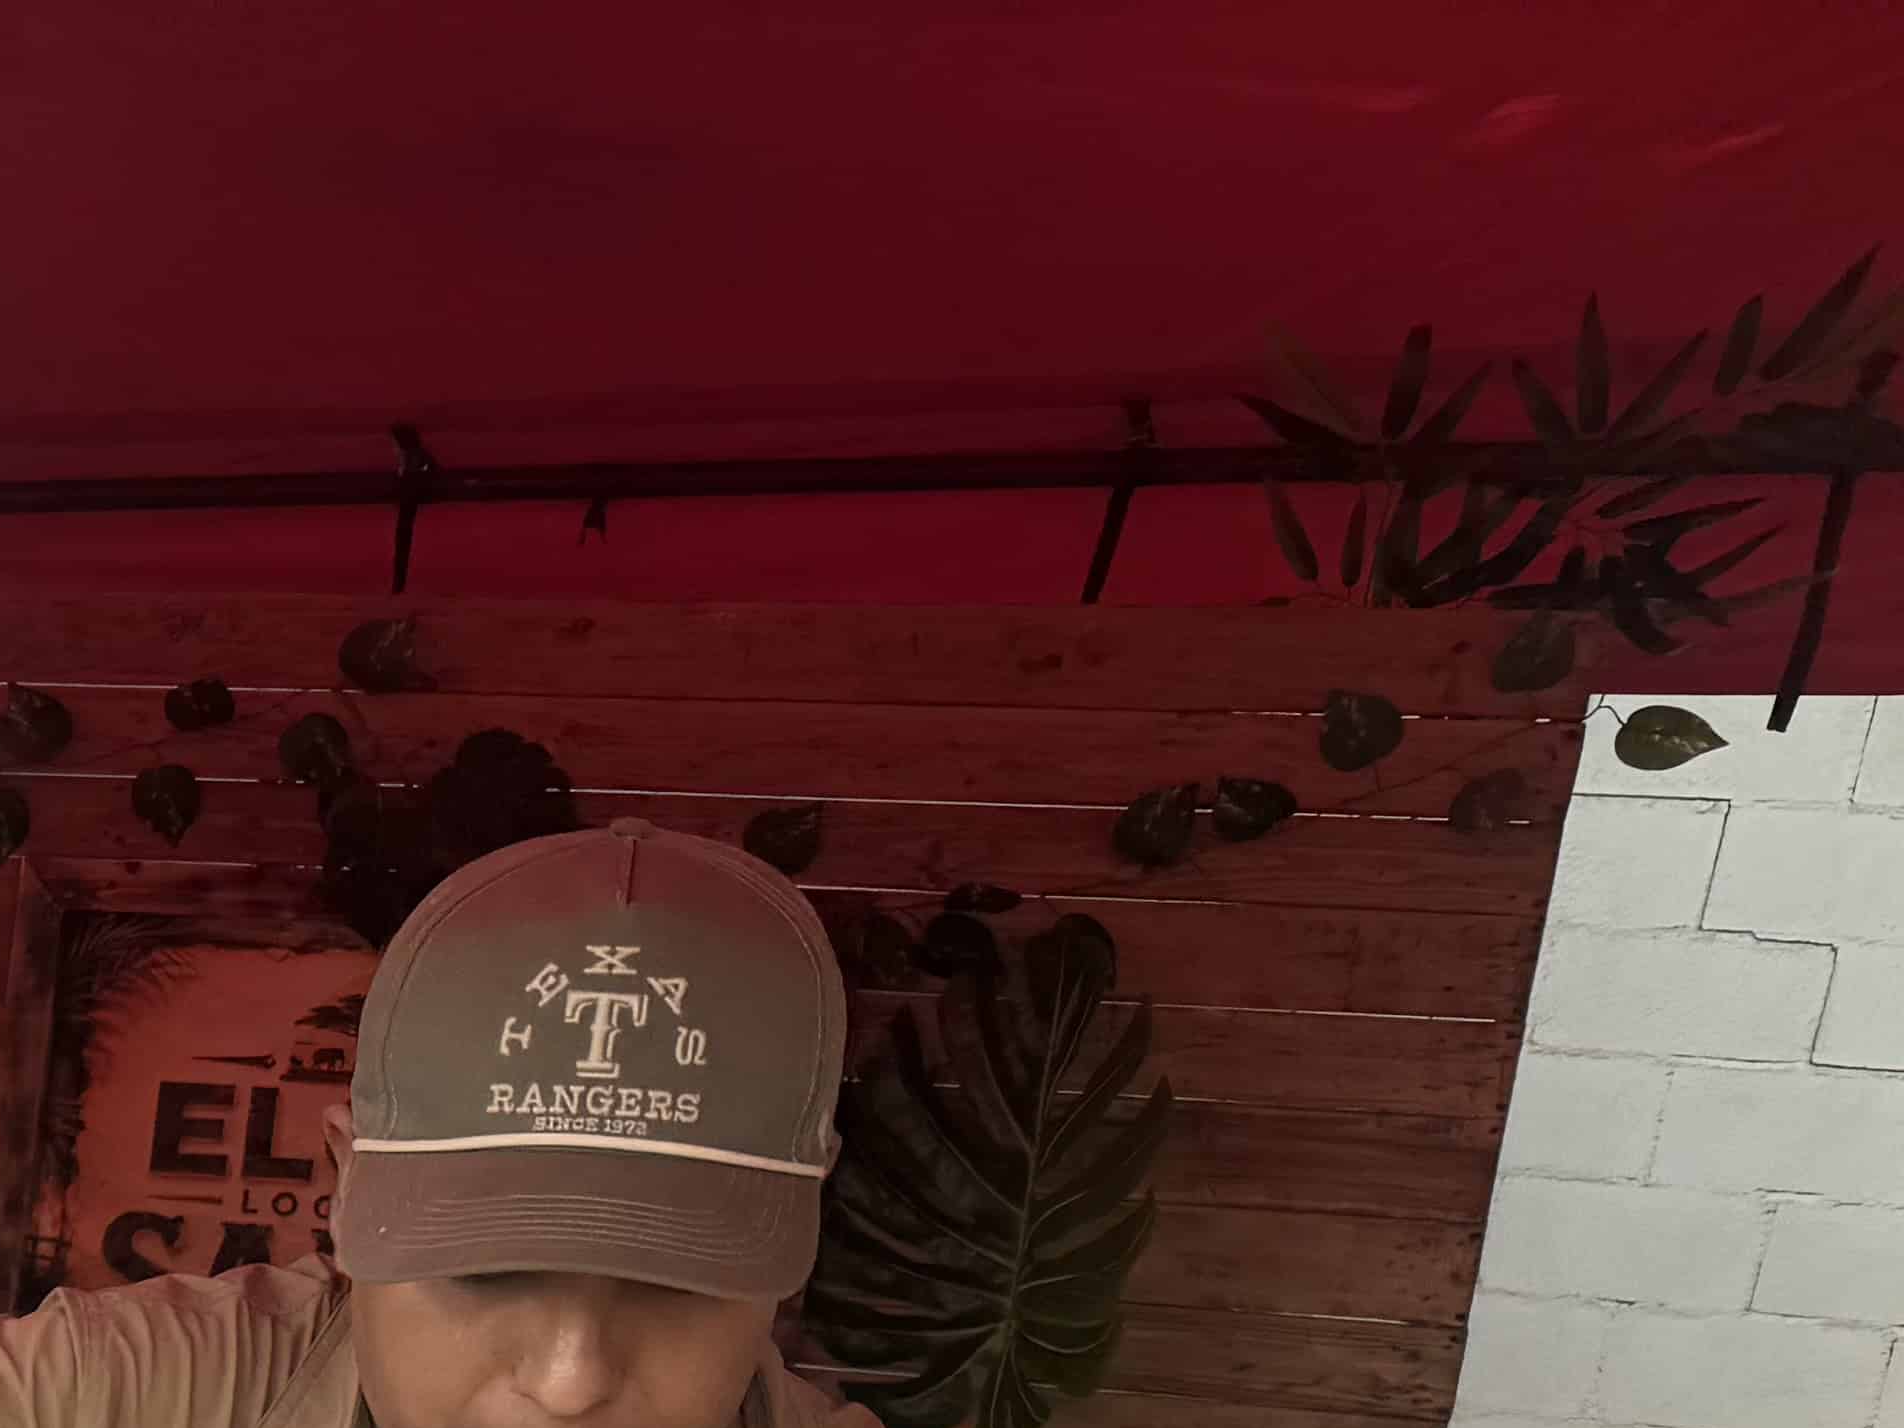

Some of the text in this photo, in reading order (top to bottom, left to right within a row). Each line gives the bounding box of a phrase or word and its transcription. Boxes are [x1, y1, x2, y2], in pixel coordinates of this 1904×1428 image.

[499, 944, 708, 1067] TEXAS
[564, 989, 649, 1079] T
[149, 1080, 314, 1181] EL
[486, 1083, 702, 1123] RANGERS
[532, 1115, 599, 1132] SINCE
